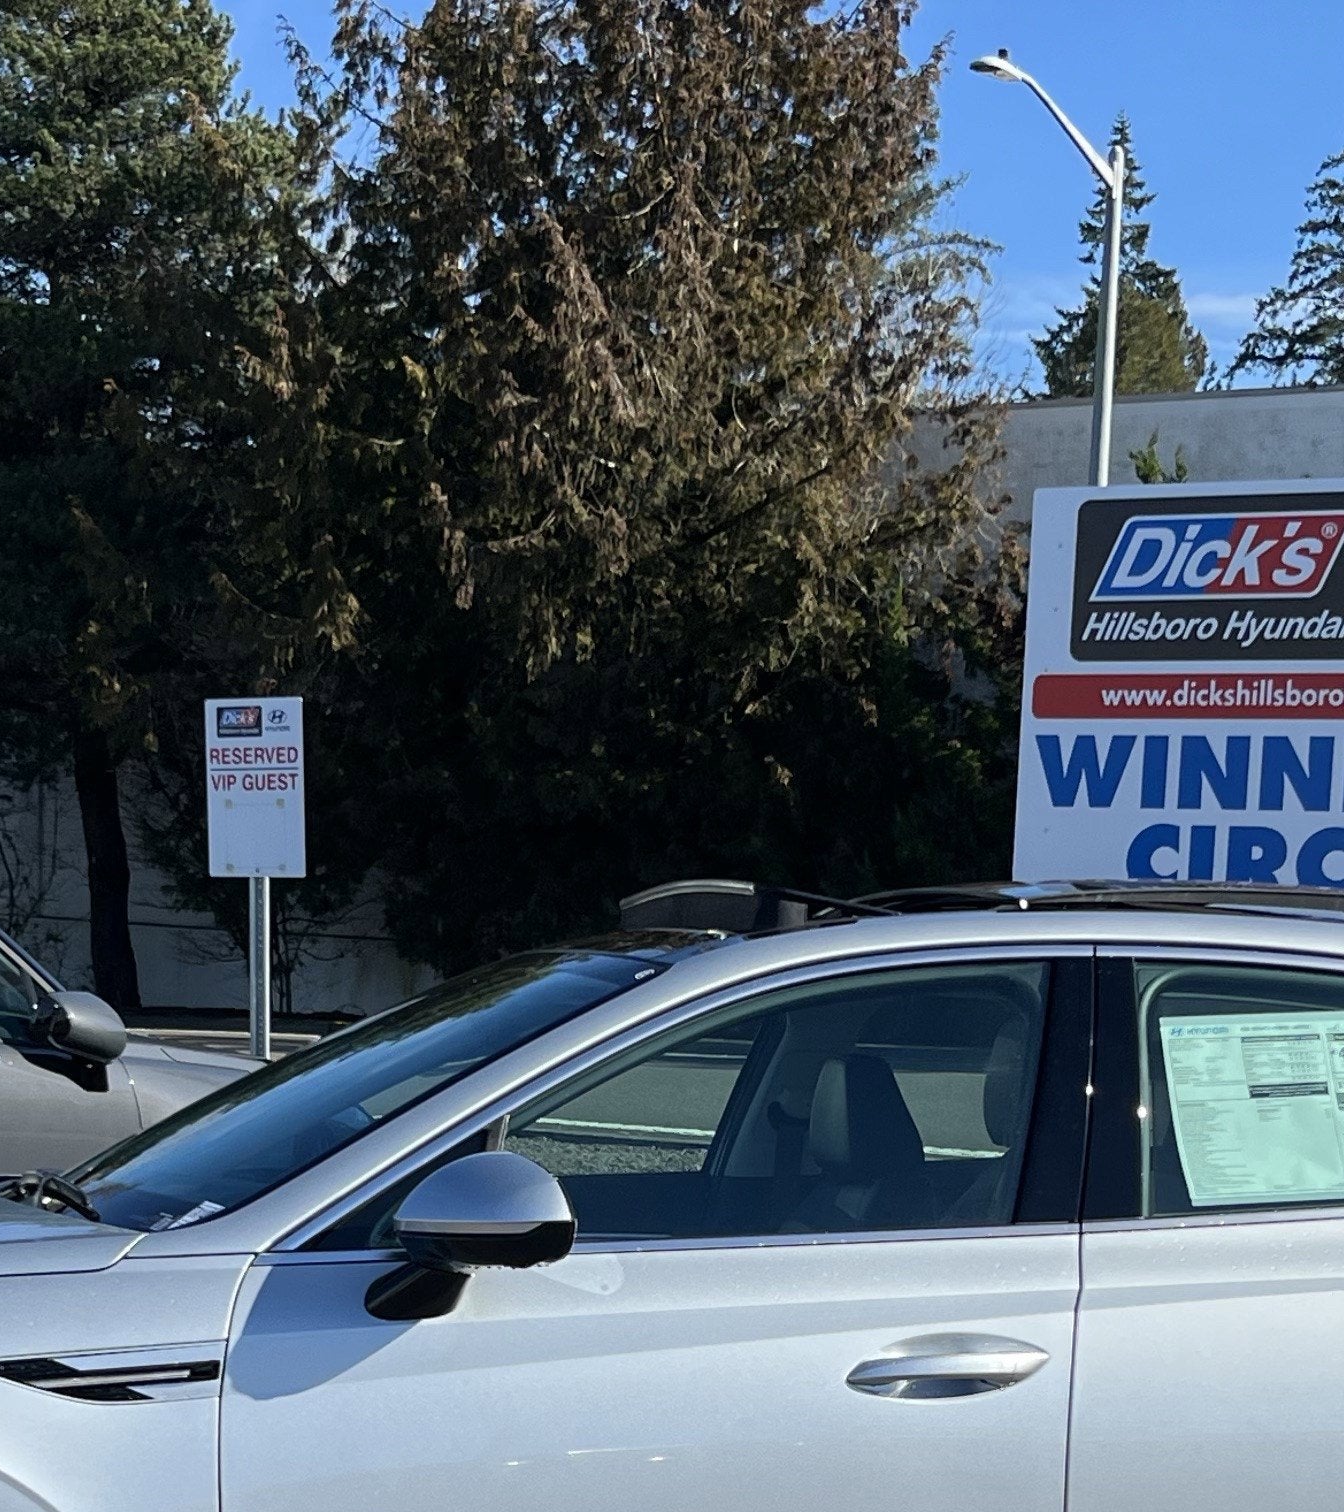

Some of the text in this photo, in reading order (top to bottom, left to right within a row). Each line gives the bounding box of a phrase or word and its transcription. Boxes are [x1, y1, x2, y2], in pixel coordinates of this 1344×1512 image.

[1110, 521, 1324, 589] Dick's
[1081, 611, 1219, 642] Hillsboro
[209, 747, 299, 765] RESERVED
[211, 773, 299, 791] VIP GUEST
